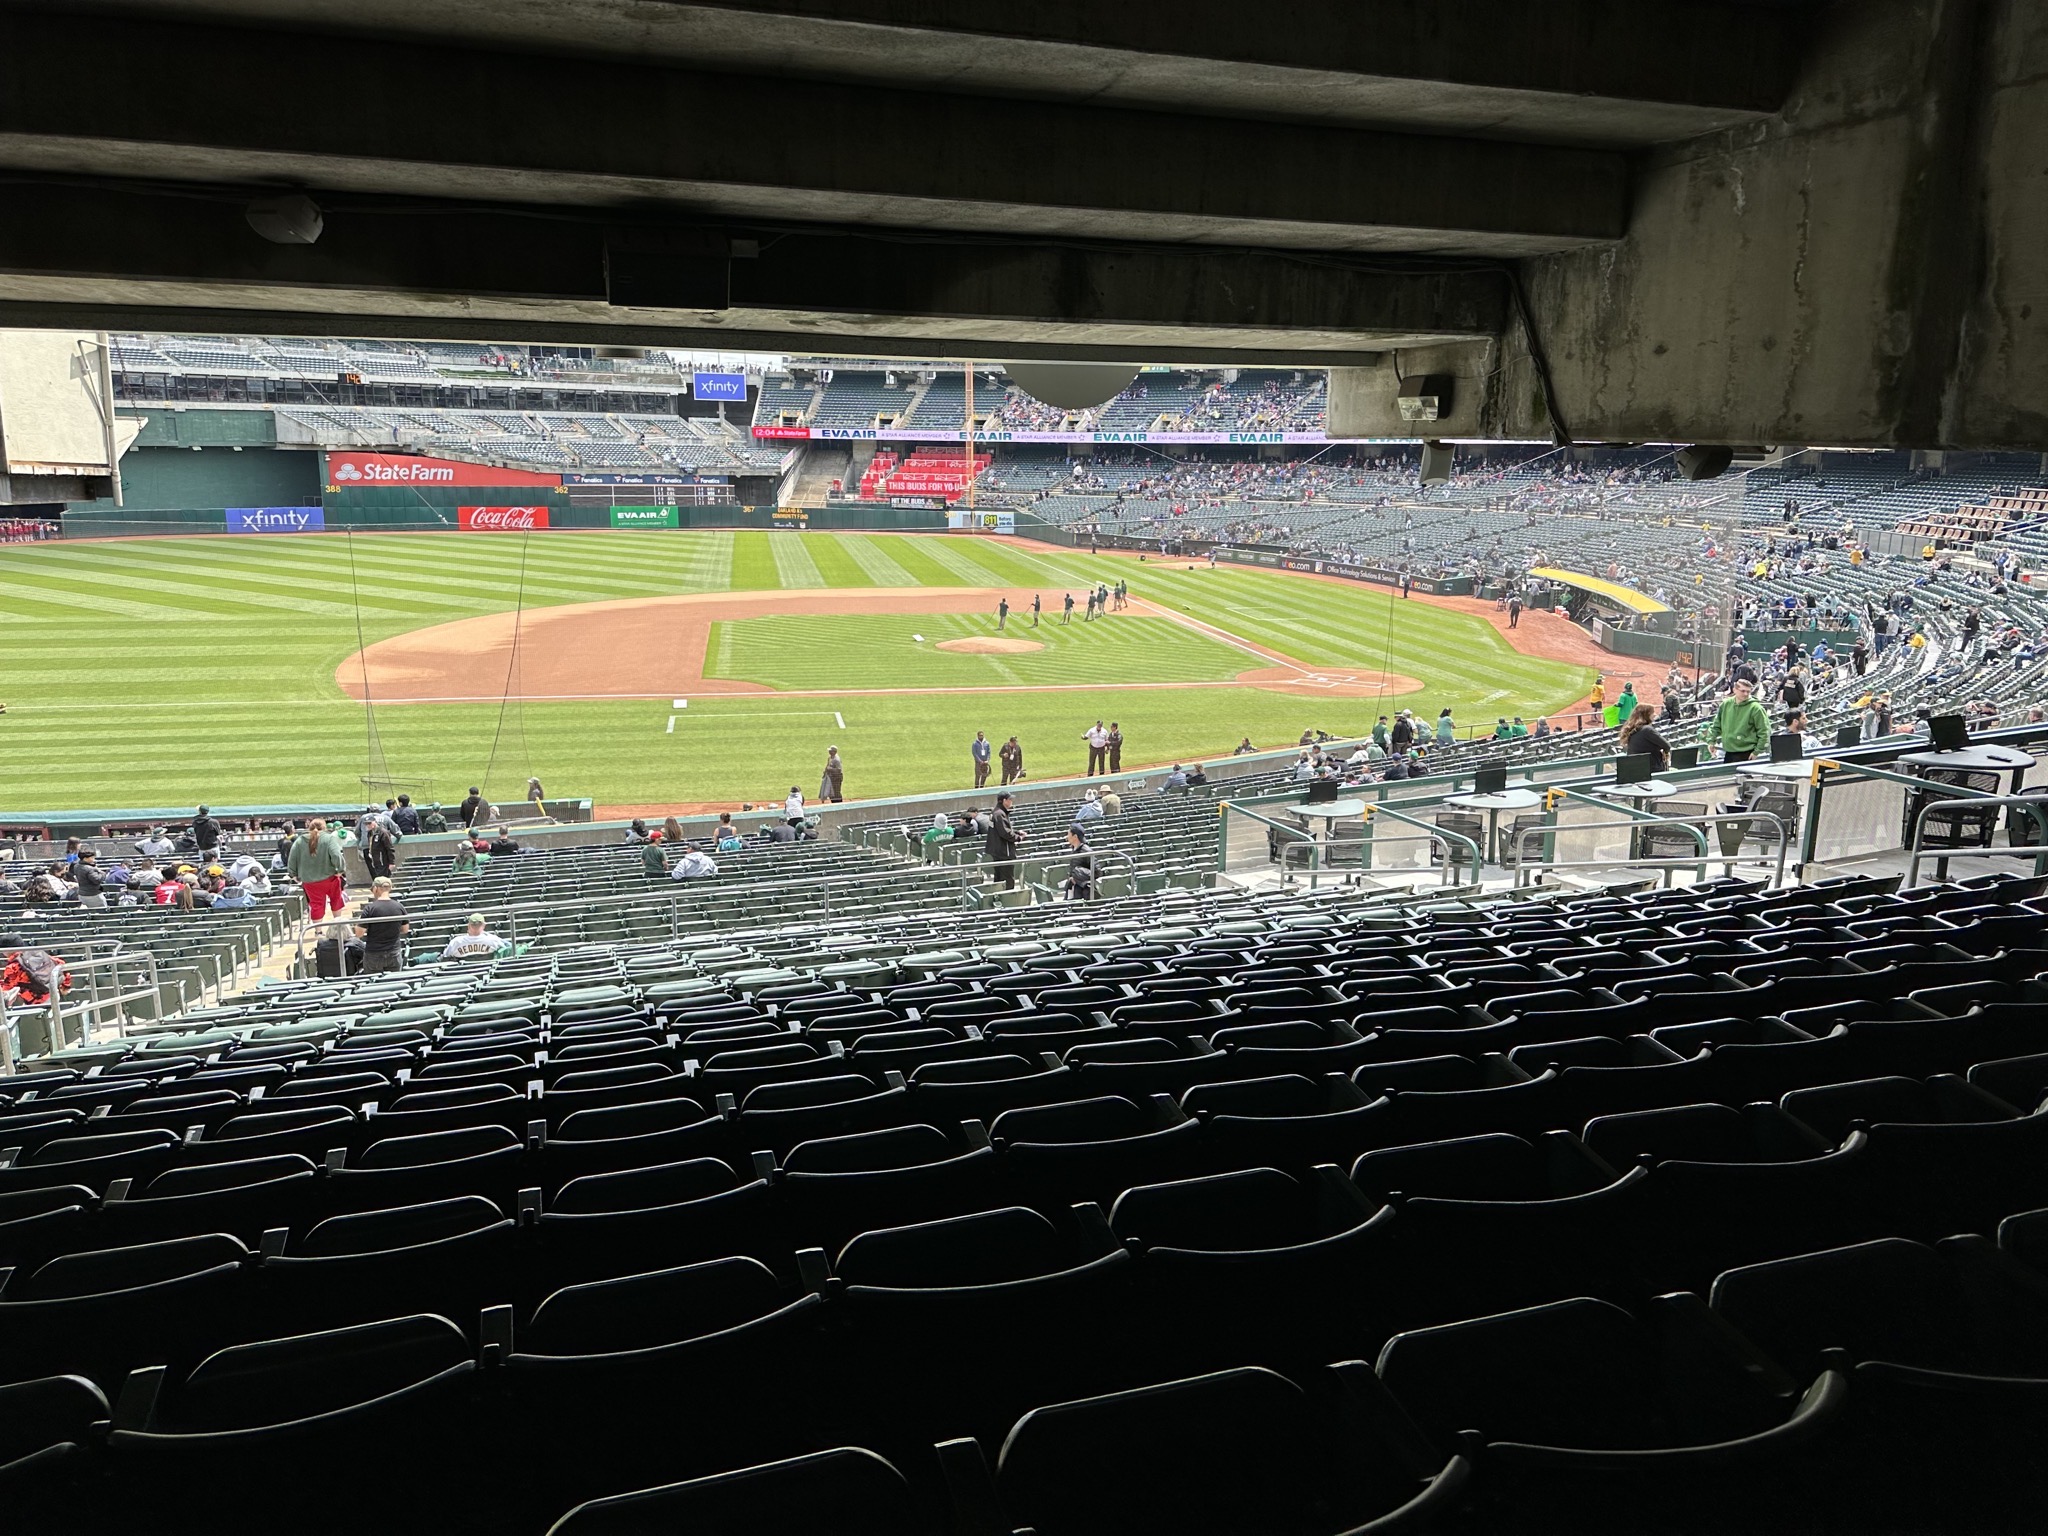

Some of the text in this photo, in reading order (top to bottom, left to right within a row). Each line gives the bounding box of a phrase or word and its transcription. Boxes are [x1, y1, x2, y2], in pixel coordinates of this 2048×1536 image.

[701, 380, 739, 394] xfinity
[364, 464, 453, 480] State Farm
[888, 482, 905, 490] THIS
[242, 510, 309, 532] xfinity
[470, 507, 536, 529] Coca-Cola
[984, 515, 997, 525] 811
[1340, 567, 1360, 578] Technology
[1360, 570, 1377, 580] Solutions
[164, 890, 173, 903] 7
[458, 944, 490, 955] REDDICK
